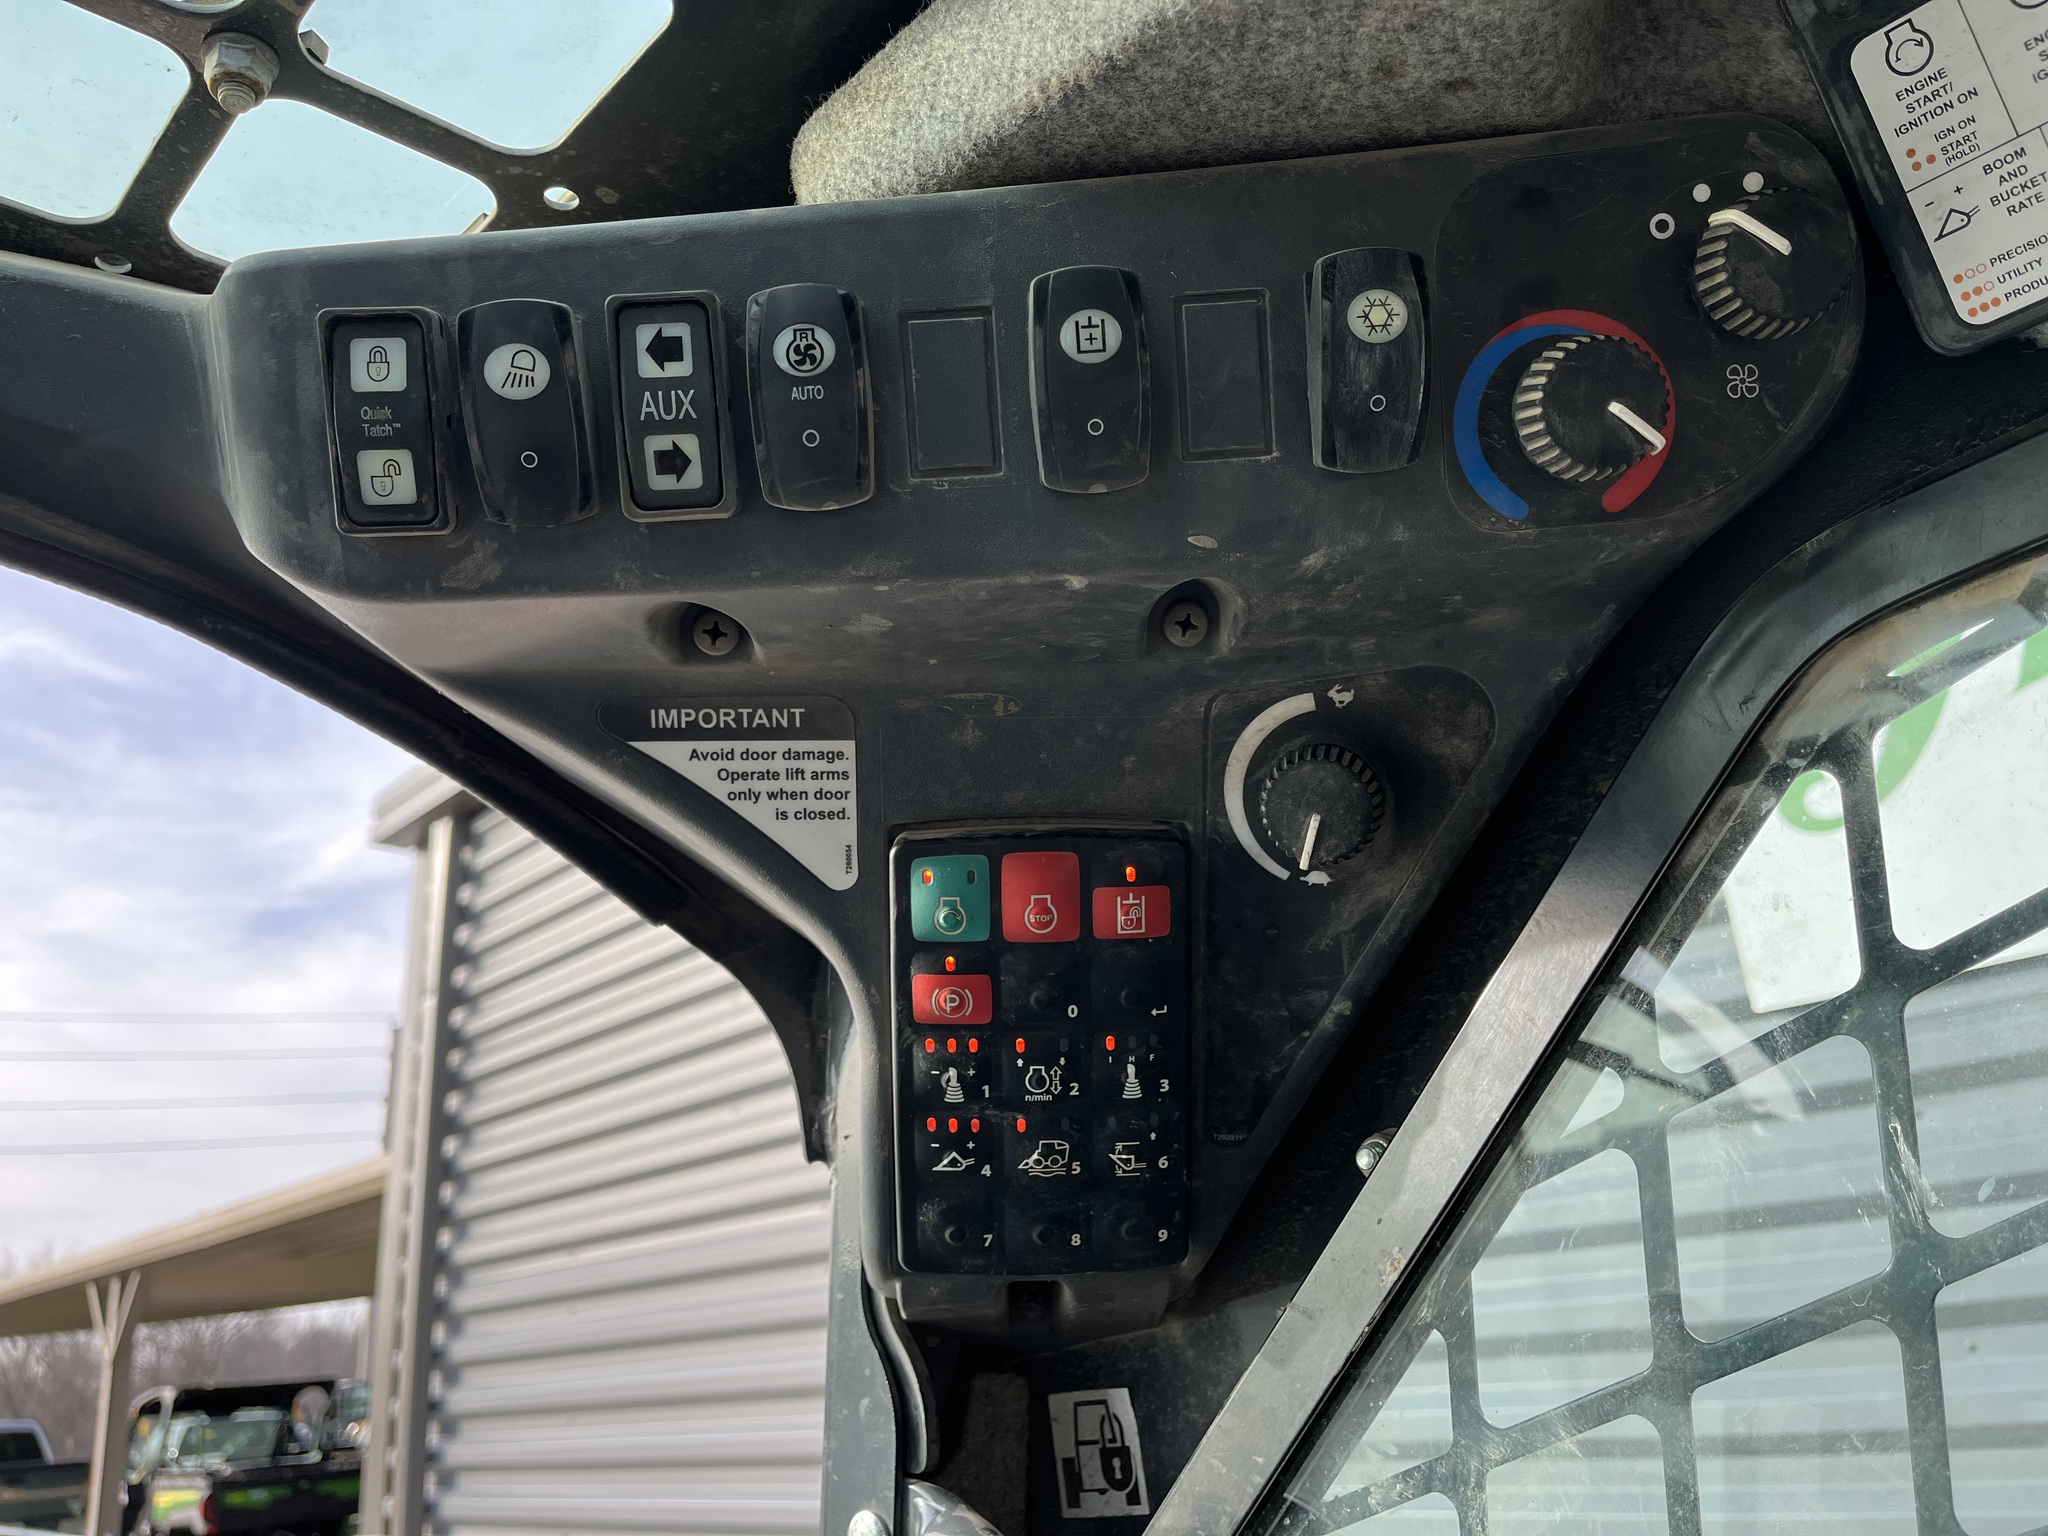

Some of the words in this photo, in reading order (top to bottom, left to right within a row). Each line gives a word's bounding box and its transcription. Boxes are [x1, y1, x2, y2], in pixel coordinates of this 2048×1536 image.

[2038, 50, 2048, 61] S
[1895, 67, 1948, 102] ENGINE
[2032, 69, 2048, 84] IG
[1905, 81, 1953, 114] START/
[1894, 99, 1954, 138] IGNITION
[1956, 87, 1979, 104] ON
[1934, 125, 1956, 142] IGN
[1957, 115, 1976, 130] ON
[1940, 130, 1978, 156] START
[1945, 142, 1981, 166] (HOLD)
[1982, 146, 2027, 176] BOOM
[1999, 164, 2028, 187] AND
[1989, 171, 2047, 207] BUCKET
[2006, 191, 2046, 217] RATE
[1989, 233, 2048, 268] PRECISIO
[1996, 257, 2042, 284] UTILITY
[791, 385, 825, 401] AUTO
[360, 406, 393, 420] Quick
[639, 390, 698, 421] AUX
[650, 708, 806, 730] IMPORTANT
[689, 748, 735, 762] Avoid
[740, 748, 777, 761] door
[782, 748, 849, 764] damage.
[717, 767, 780, 784] Operate
[785, 767, 806, 781] lift
[810, 769, 850, 781] arms
[727, 788, 761, 804] only
[766, 788, 809, 801] when
[813, 788, 851, 801] door
[775, 807, 789, 821] is
[793, 807, 851, 821] closed.
[1029, 914, 1053, 923] STOP
[945, 994, 960, 1014] P
[1067, 1004, 1079, 1018] 0
[1128, 1055, 1136, 1063] H
[1149, 1053, 1156, 1062] F
[981, 1085, 990, 1098] 1
[1069, 1082, 1080, 1096] 2
[1160, 1078, 1170, 1092] 3
[1024, 1093, 1053, 1102] n/min
[1071, 1161, 1082, 1174] 5
[1157, 1155, 1169, 1169] 6
[980, 1164, 992, 1177] 4
[983, 1234, 993, 1248] 7
[1070, 1233, 1082, 1247] 8
[1157, 1229, 1169, 1242] 9
